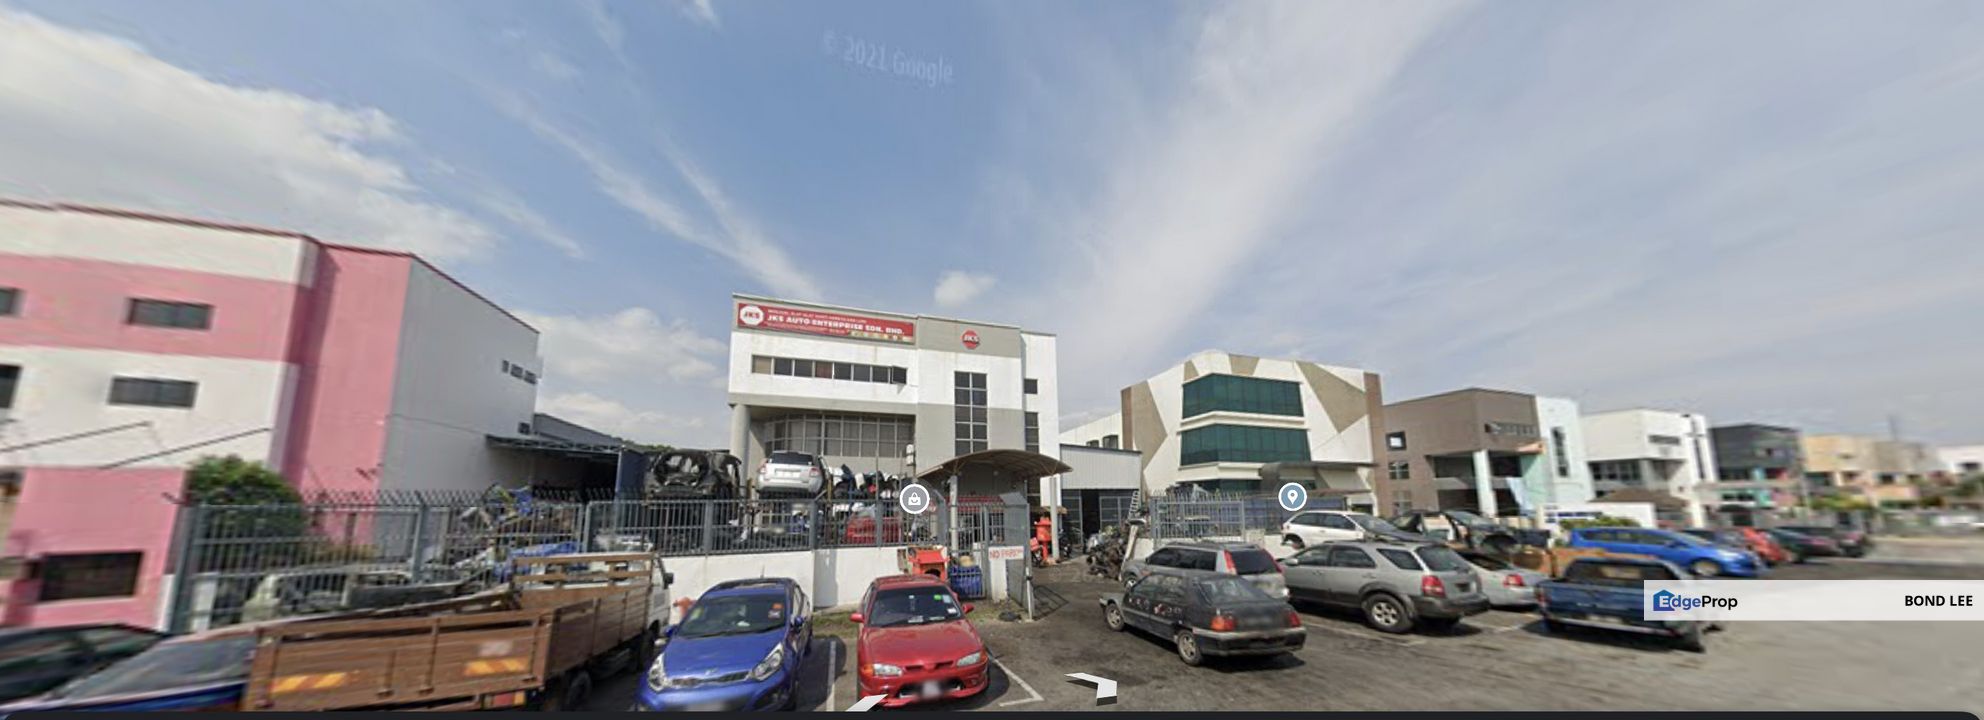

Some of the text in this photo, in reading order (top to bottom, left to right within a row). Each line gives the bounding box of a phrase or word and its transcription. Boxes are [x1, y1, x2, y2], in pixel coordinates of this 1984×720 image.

[767, 314, 785, 322] JKS
[786, 316, 810, 325] AUTO
[812, 319, 863, 330] ENTERPRISE
[865, 324, 884, 333] SDN.
[885, 327, 905, 335] BHD.
